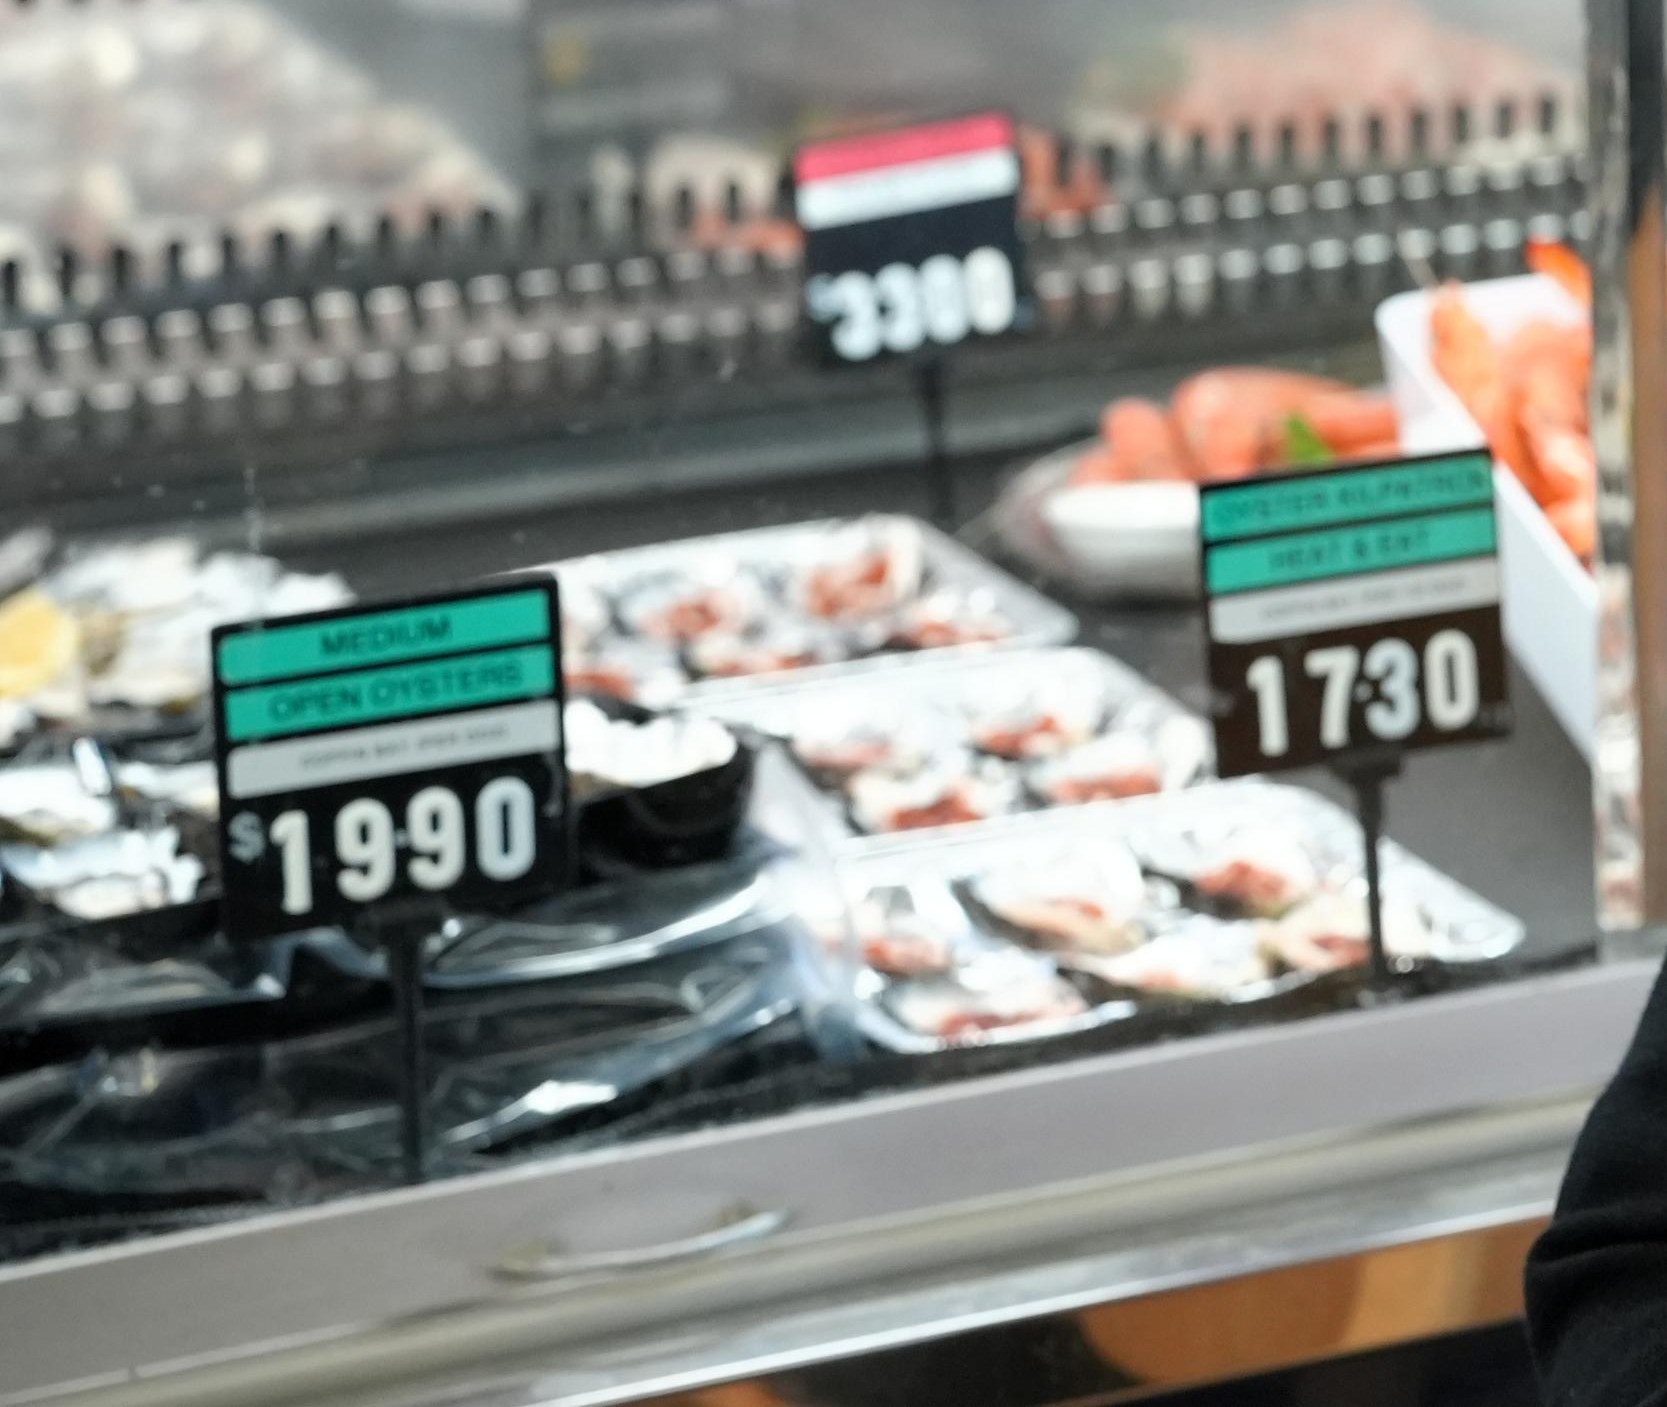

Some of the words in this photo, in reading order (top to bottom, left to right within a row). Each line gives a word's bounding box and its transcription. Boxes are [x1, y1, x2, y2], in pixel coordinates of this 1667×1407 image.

[1269, 539, 1342, 571] HEAT
[318, 614, 450, 654] MEDIUM
[266, 683, 362, 722] OPEN
[369, 660, 523, 705] OYSTERS
